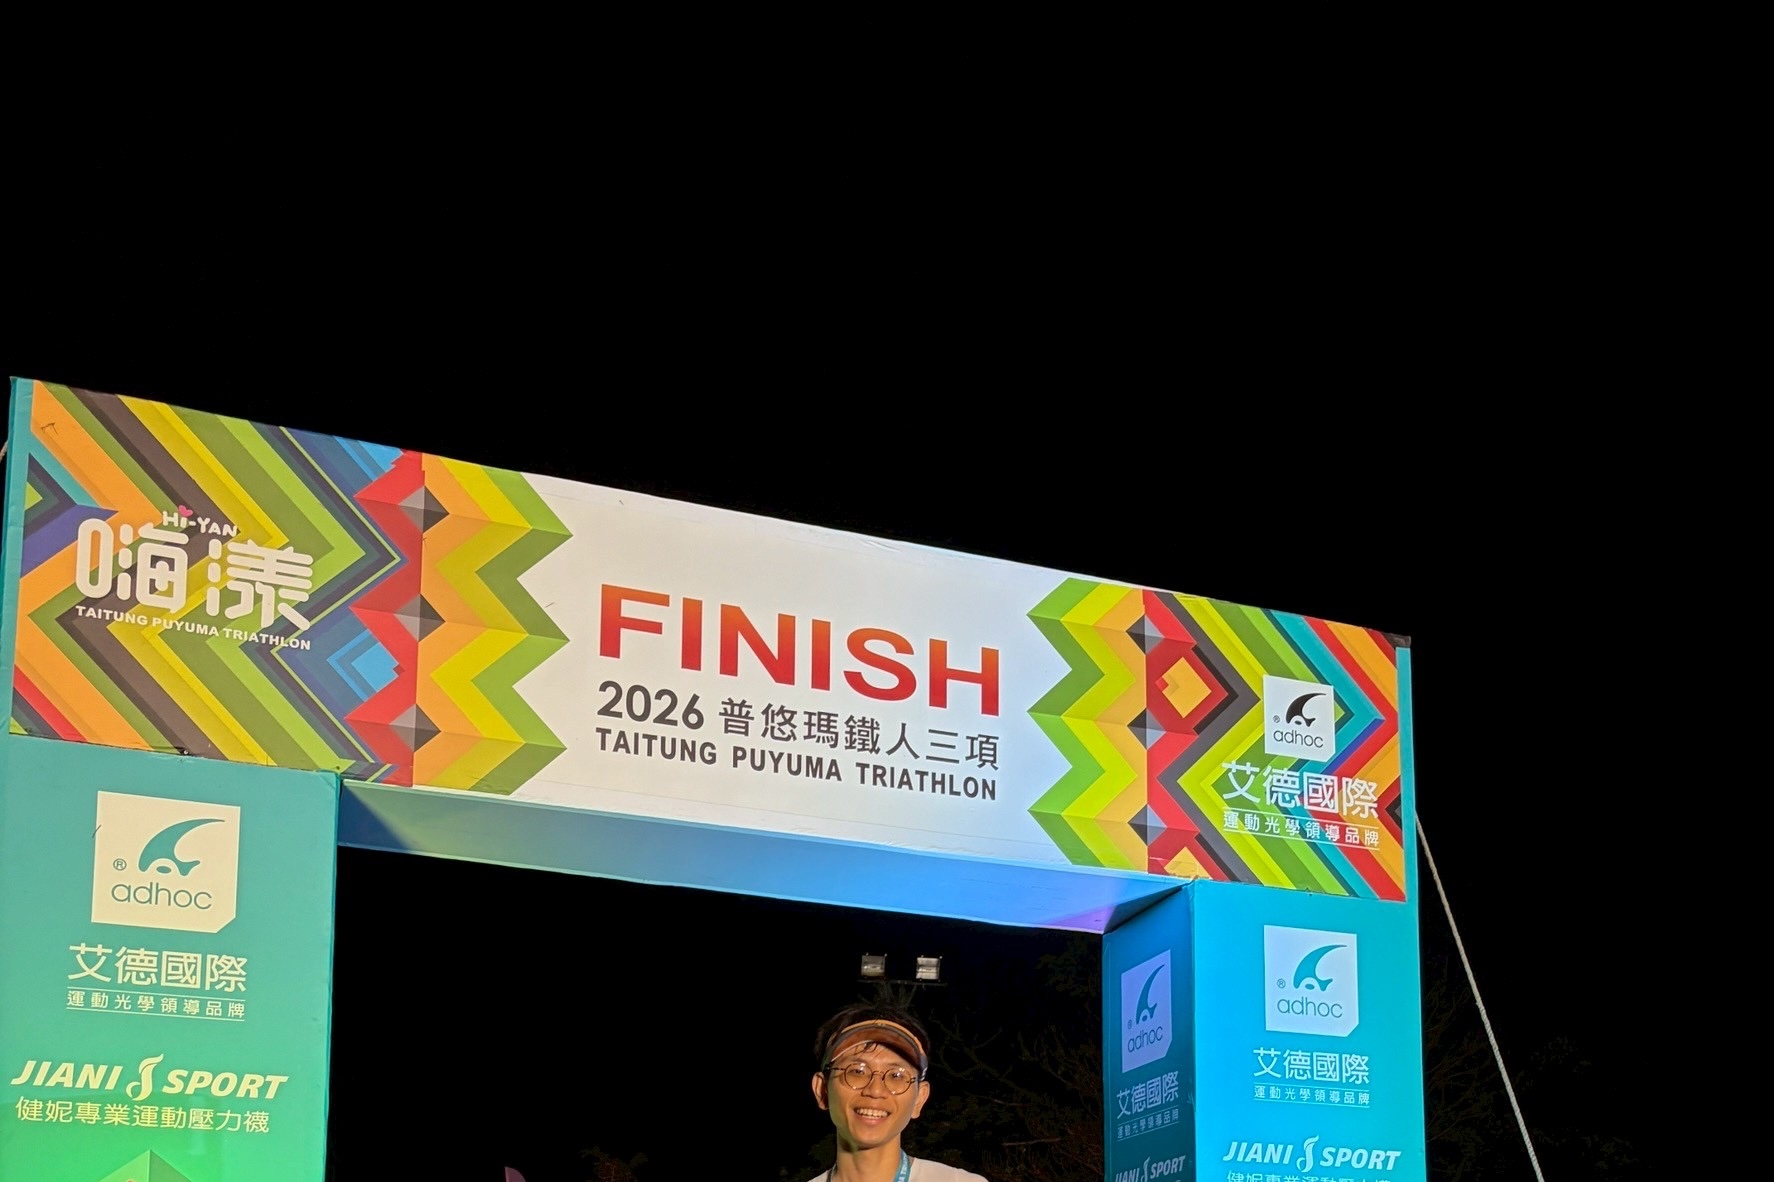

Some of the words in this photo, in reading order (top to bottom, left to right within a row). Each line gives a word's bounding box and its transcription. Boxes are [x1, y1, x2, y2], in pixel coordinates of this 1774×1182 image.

[76, 518, 313, 631] 嗨漾
[75, 605, 148, 626] TAITUNG
[152, 617, 220, 637] PUYUMA
[223, 628, 311, 650] TRIATHLON
[599, 584, 1000, 717] FINISH
[597, 680, 705, 730] 2026
[718, 697, 999, 771] 普悠瑪鐵人三項
[1273, 729, 1324, 749] adhoc
[595, 727, 718, 765] TAITUNG
[732, 746, 843, 781] PUYUMA
[855, 762, 997, 801] TRIATHLON
[1222, 760, 1380, 820] 艾德國際
[1223, 811, 1380, 848] 運動光學領導品牌
[111, 882, 213, 910] adhoc
[68, 943, 248, 993] 艾德國際
[66, 990, 246, 1019] 運動光學領導品牌
[1277, 997, 1343, 1019] adhoc
[1127, 1025, 1164, 1053] adhoc
[11, 1060, 123, 1090] JIANI
[161, 1069, 289, 1100] SPORT
[1253, 1048, 1370, 1085] 艾德國際
[1116, 1071, 1180, 1120] 艾德國際
[1254, 1085, 1370, 1106] 運動光學領導品牌
[15, 1096, 270, 1133] 健妮專業運動壓力襪
[1150, 1155, 1186, 1180] SPORT
[1223, 1141, 1294, 1166] JIANI
[1320, 1147, 1402, 1172] SPORT
